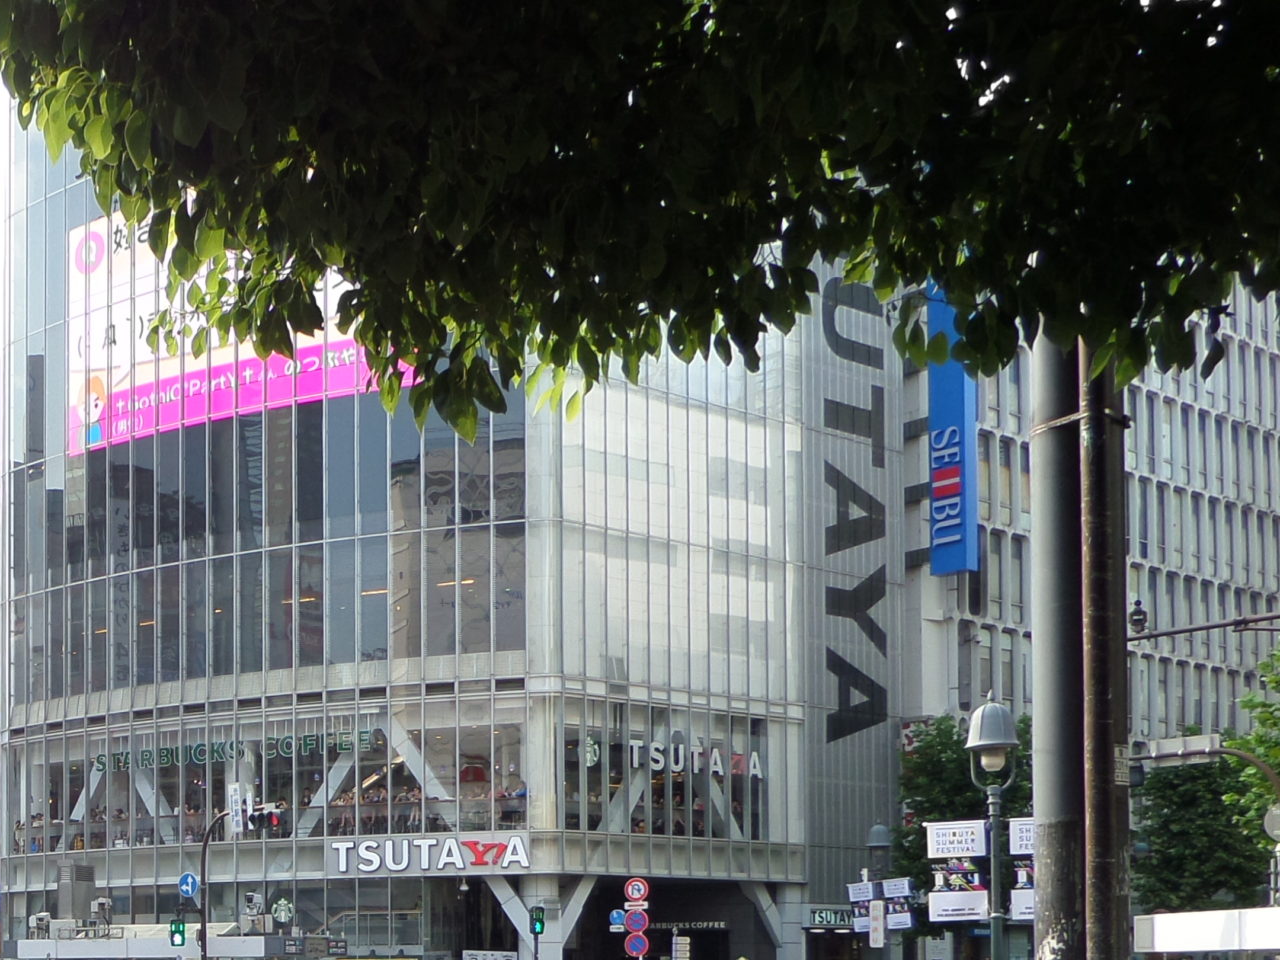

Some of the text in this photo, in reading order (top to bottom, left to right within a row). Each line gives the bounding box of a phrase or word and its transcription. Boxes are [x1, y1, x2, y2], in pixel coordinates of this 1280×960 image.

[95, 729, 372, 773] STARBUCKS COFFEE
[936, 830, 976, 839] SHIBUYA
[936, 838, 976, 846] SUMMER
[936, 846, 977, 854] FESTIVAL
